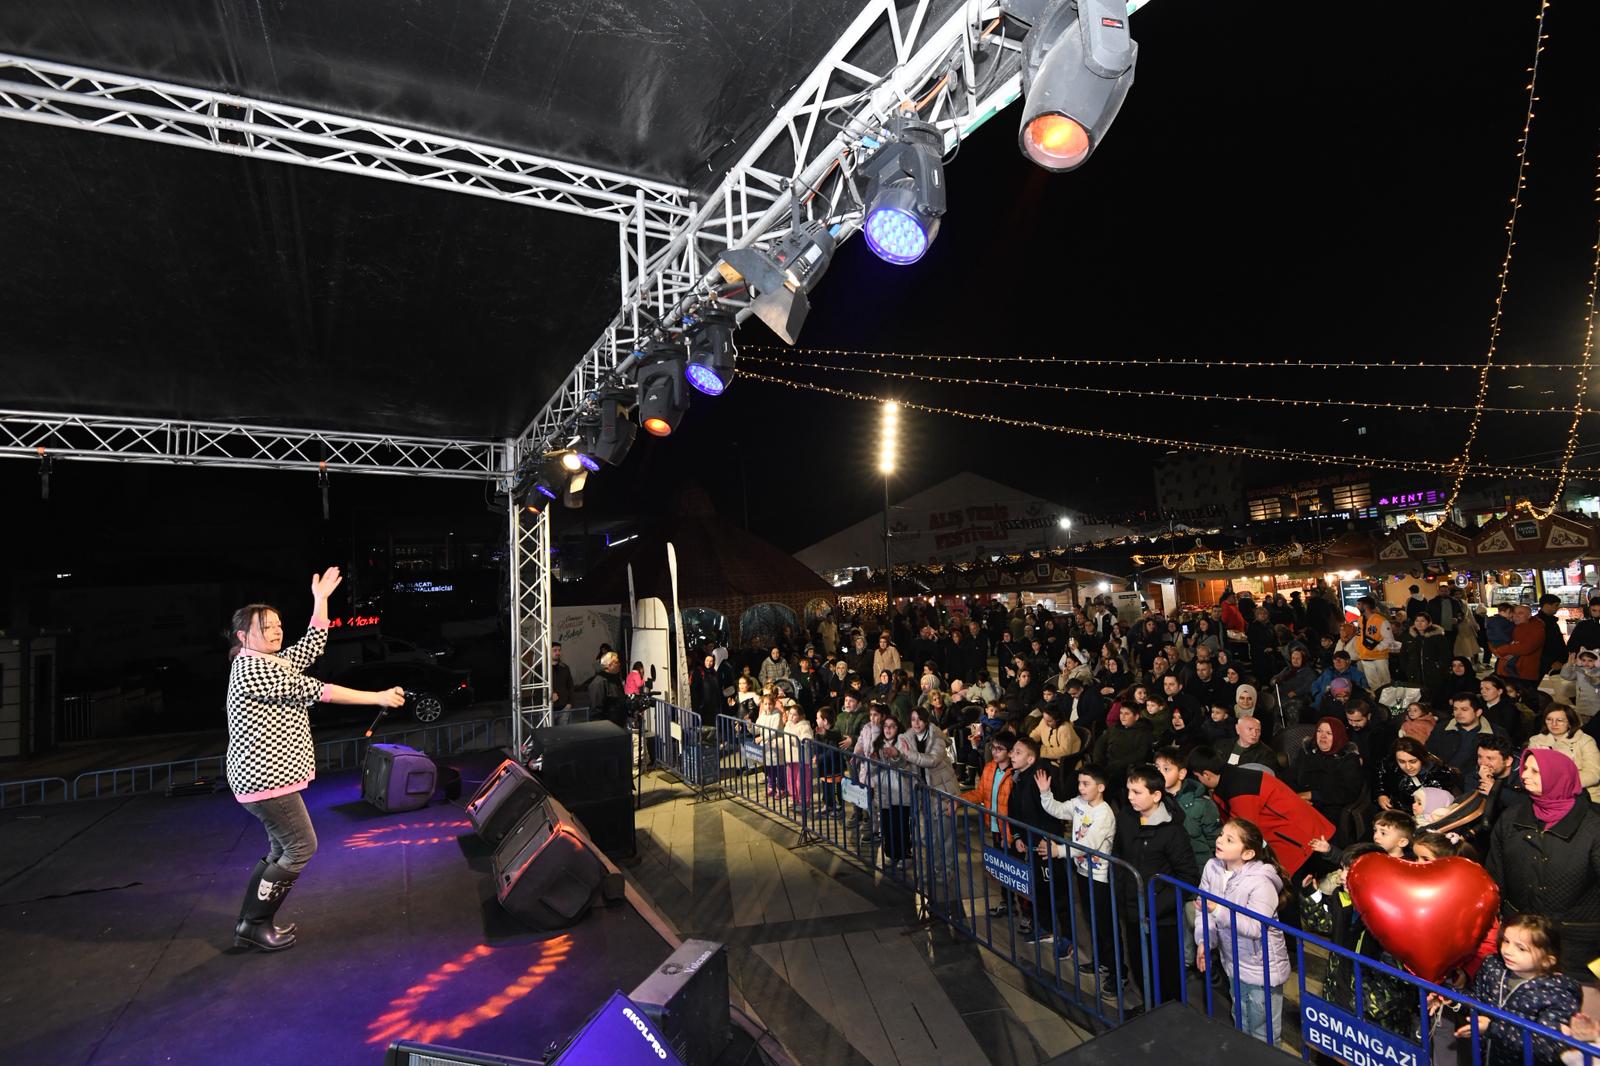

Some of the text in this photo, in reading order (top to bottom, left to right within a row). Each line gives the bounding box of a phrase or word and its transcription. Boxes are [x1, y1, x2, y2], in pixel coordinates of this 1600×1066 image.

[1391, 492, 1423, 505] KENT
[983, 852, 1029, 882] OSMANGAZİ
[985, 865, 1029, 895] BELEDİYESİ
[622, 1007, 667, 1060] AKOLPRO
[1305, 1006, 1417, 1066] OSMANGAZİ
